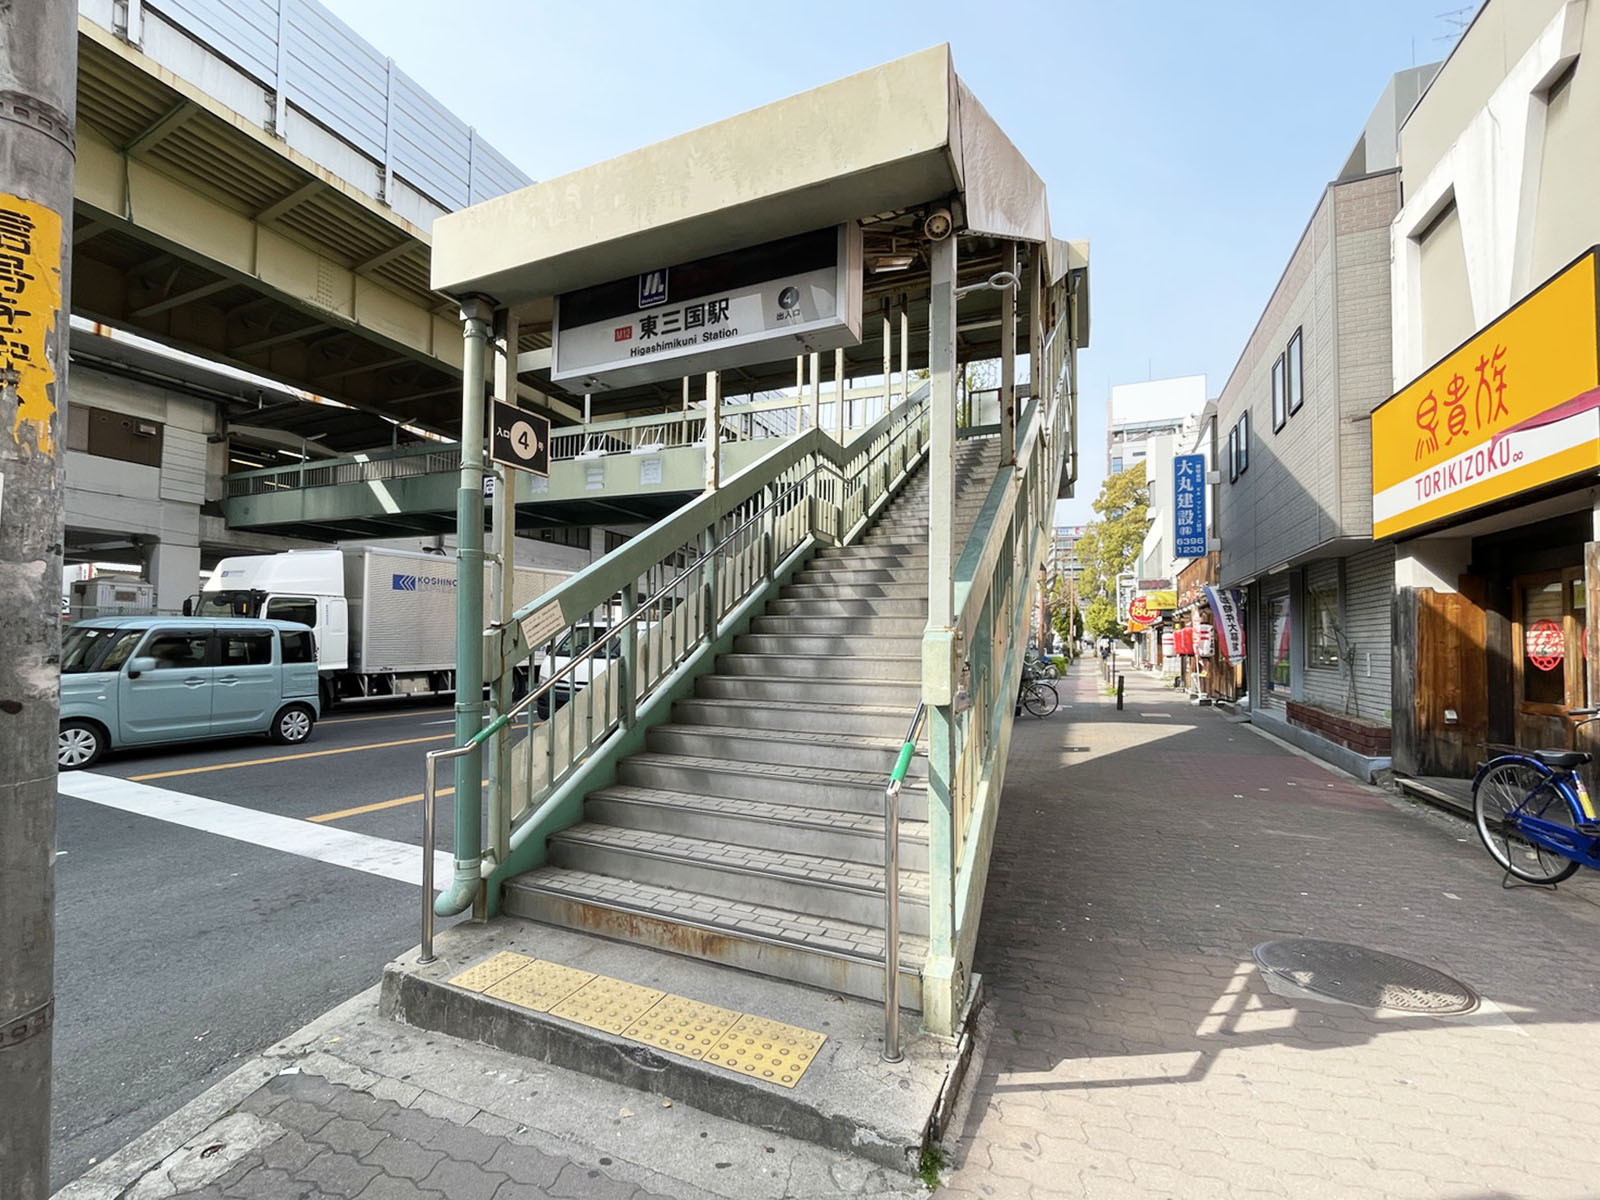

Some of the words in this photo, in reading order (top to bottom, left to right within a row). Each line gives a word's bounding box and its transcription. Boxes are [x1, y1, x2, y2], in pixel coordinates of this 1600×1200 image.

[783, 292, 792, 304] 4
[639, 297, 730, 340] 東三国駅
[776, 309, 801, 321] 出入口
[630, 335, 697, 357] Higashimikuni
[703, 327, 739, 342] Station
[1415, 344, 1509, 461] 鳥貴族
[496, 427, 510, 438] 入口
[518, 431, 530, 450] 4
[1177, 546, 1204, 554] 1230
